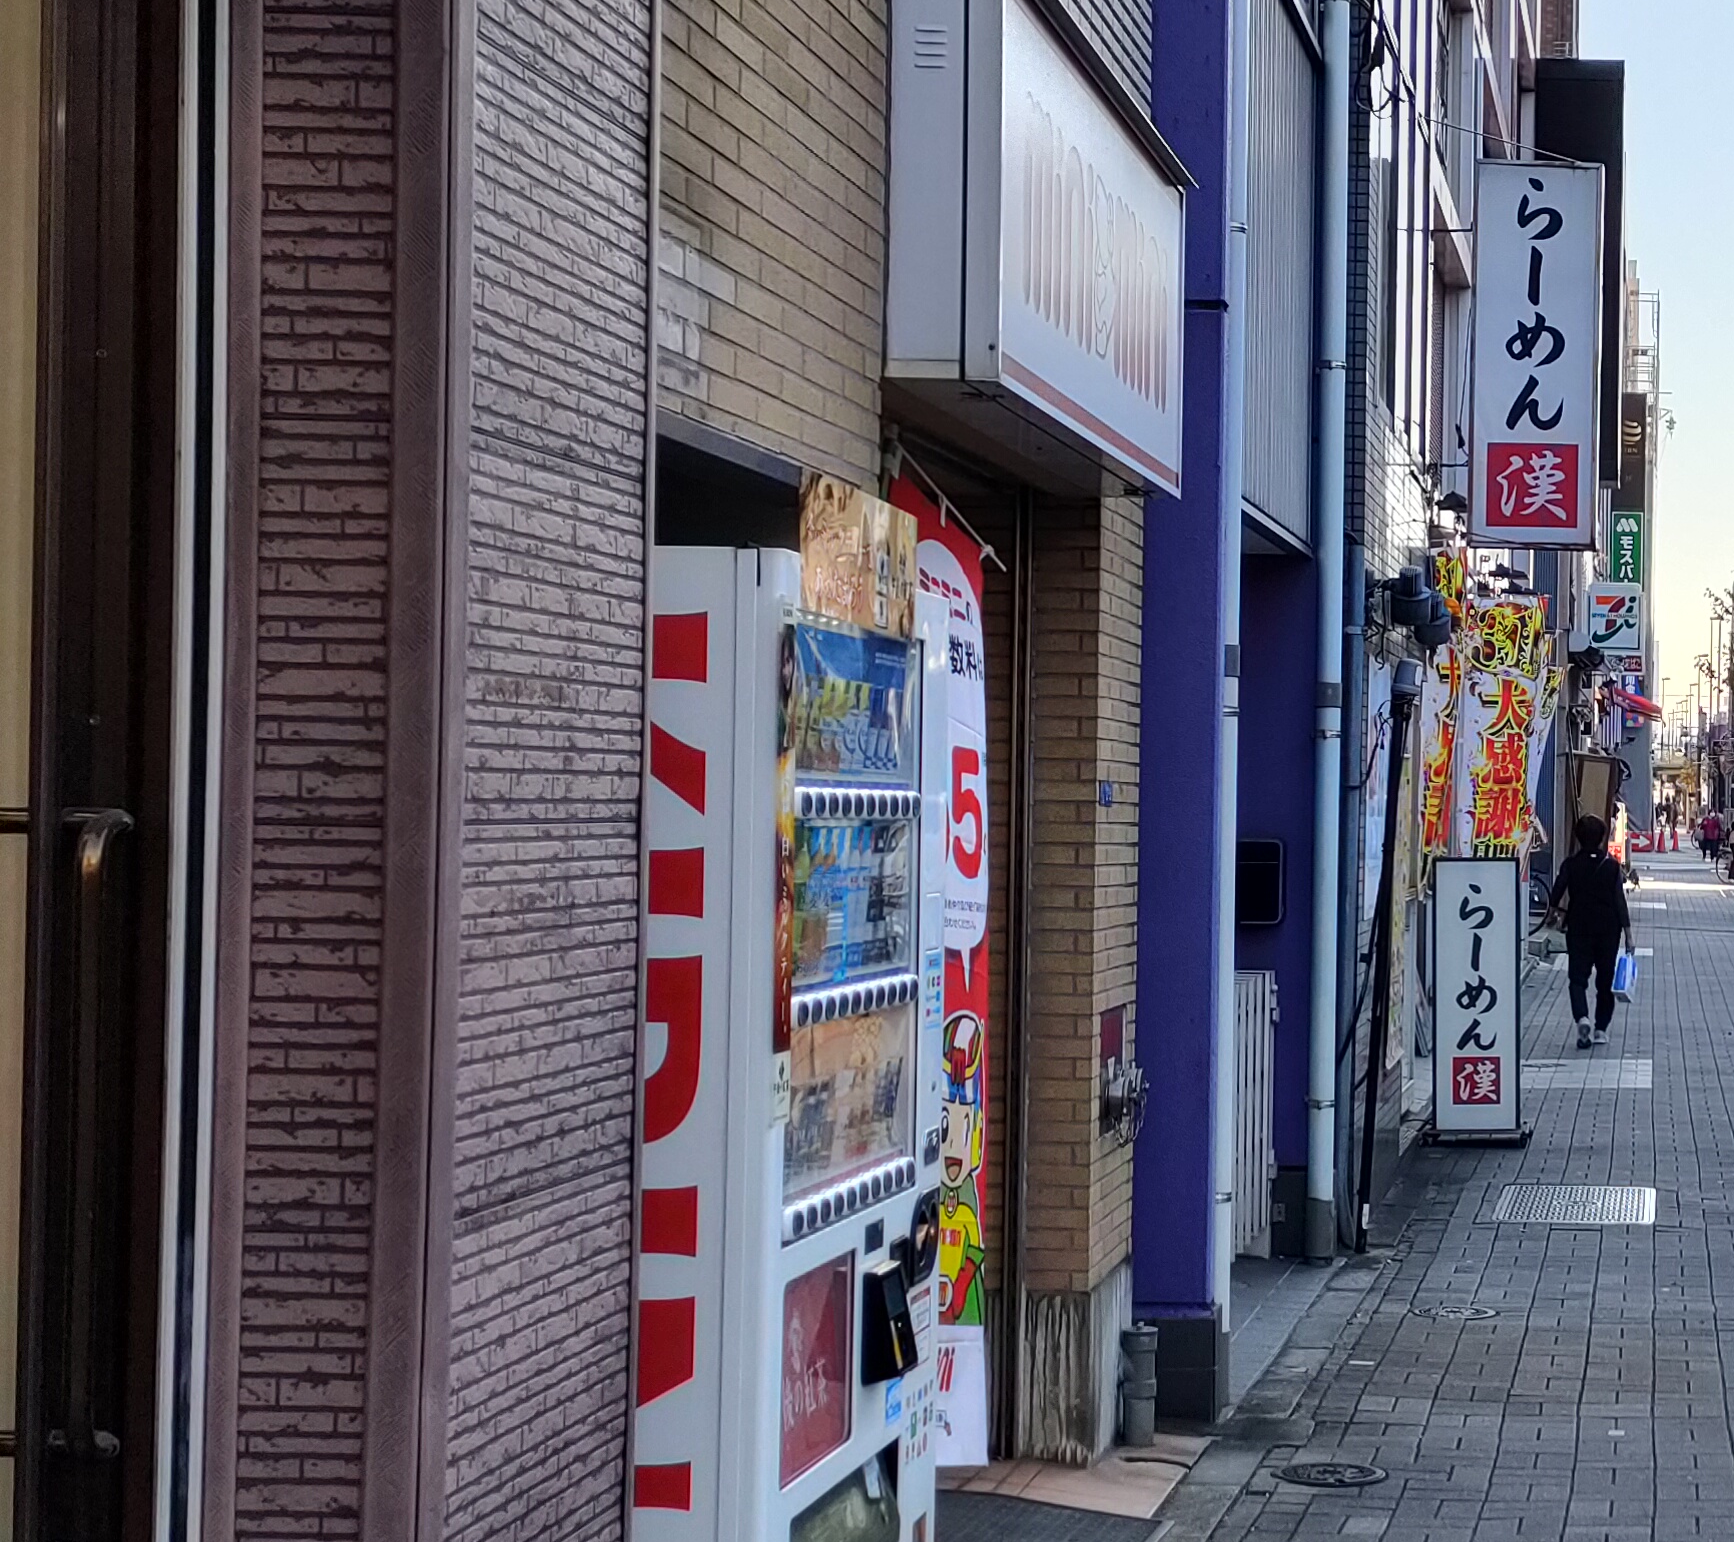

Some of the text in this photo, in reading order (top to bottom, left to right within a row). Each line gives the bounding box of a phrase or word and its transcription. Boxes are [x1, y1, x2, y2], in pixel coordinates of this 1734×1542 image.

[1505, 177, 1566, 431] らーめん
[1497, 450, 1567, 521] 漢
[1619, 535, 1634, 583] モスバ
[1456, 884, 1498, 1052] らーめん
[1457, 1060, 1498, 1101] 漢
